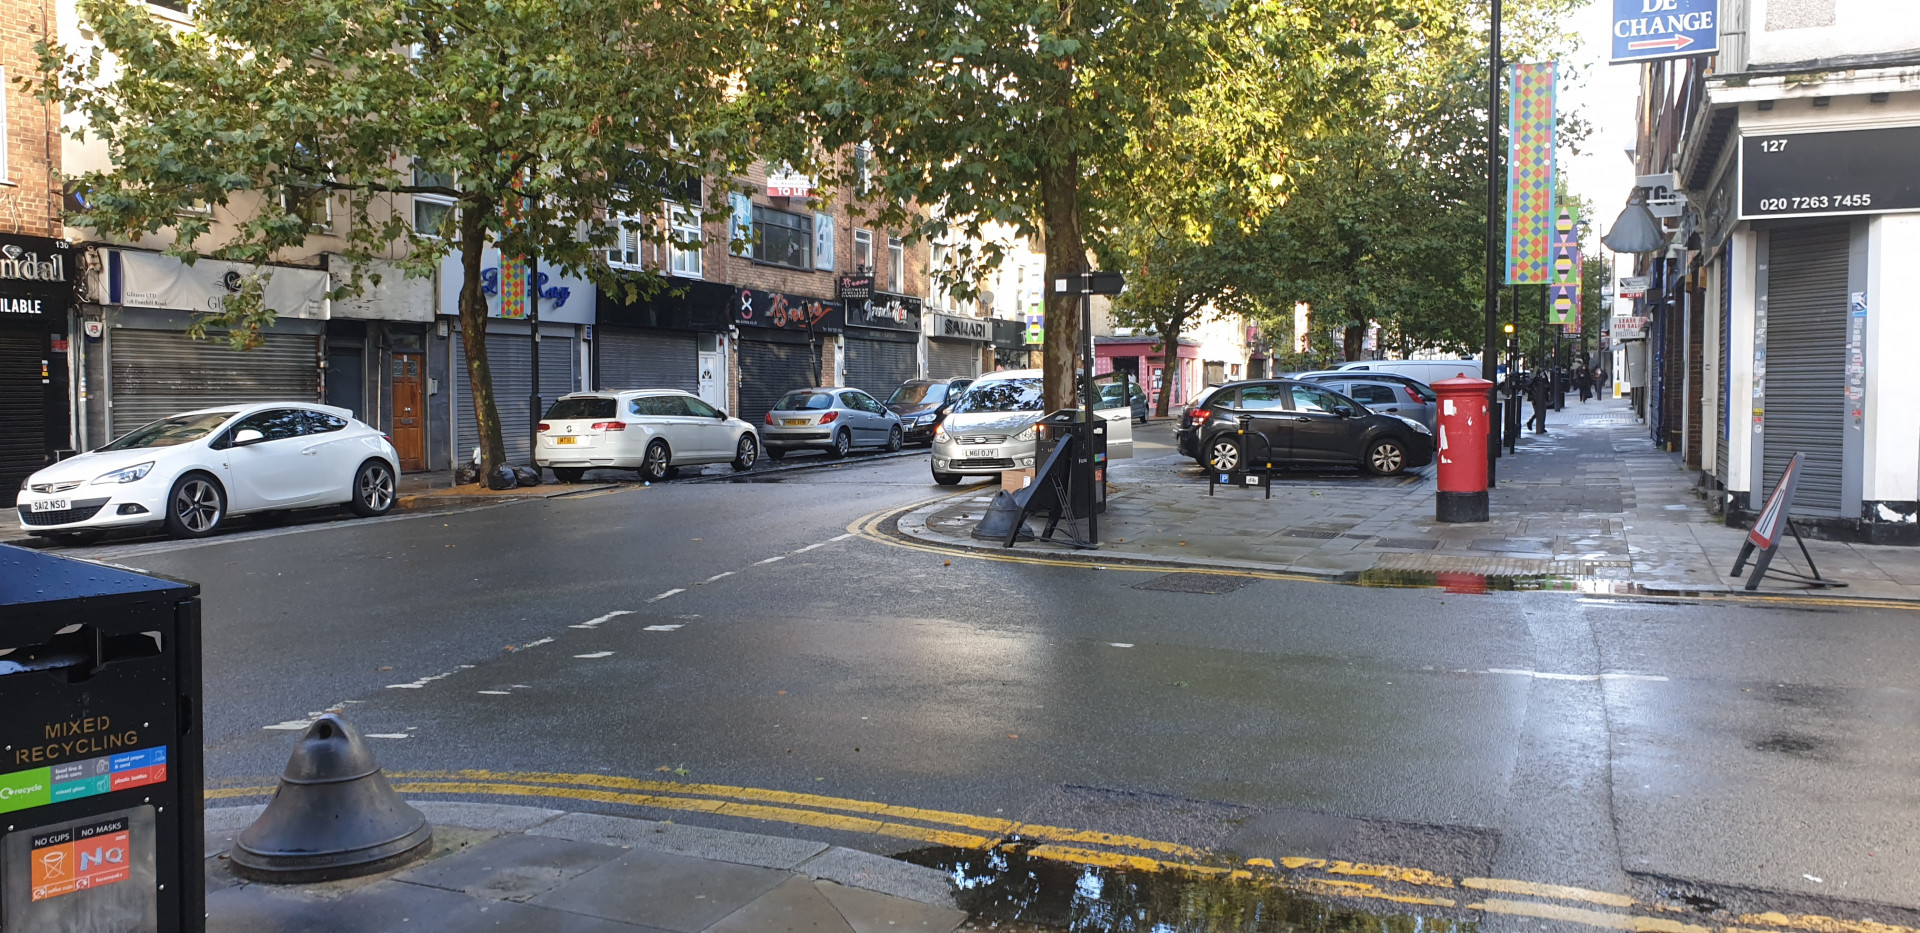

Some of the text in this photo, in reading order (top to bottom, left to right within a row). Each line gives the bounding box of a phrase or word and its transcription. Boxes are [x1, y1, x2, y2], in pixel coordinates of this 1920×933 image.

[1641, 0, 1678, 13] DE
[1614, 11, 1714, 38] CHANGE
[1760, 139, 1788, 152] 127
[778, 187, 808, 196] TO LET
[1759, 193, 1872, 211] 020 7263 7455
[35, 500, 65, 510] SA12 NSO
[45, 716, 111, 740] MIXED
[15, 730, 139, 765] RECYCLING
[14, 783, 43, 795] recycle
[81, 822, 122, 837] NO MASKS
[35, 832, 70, 847] NO CUPS
